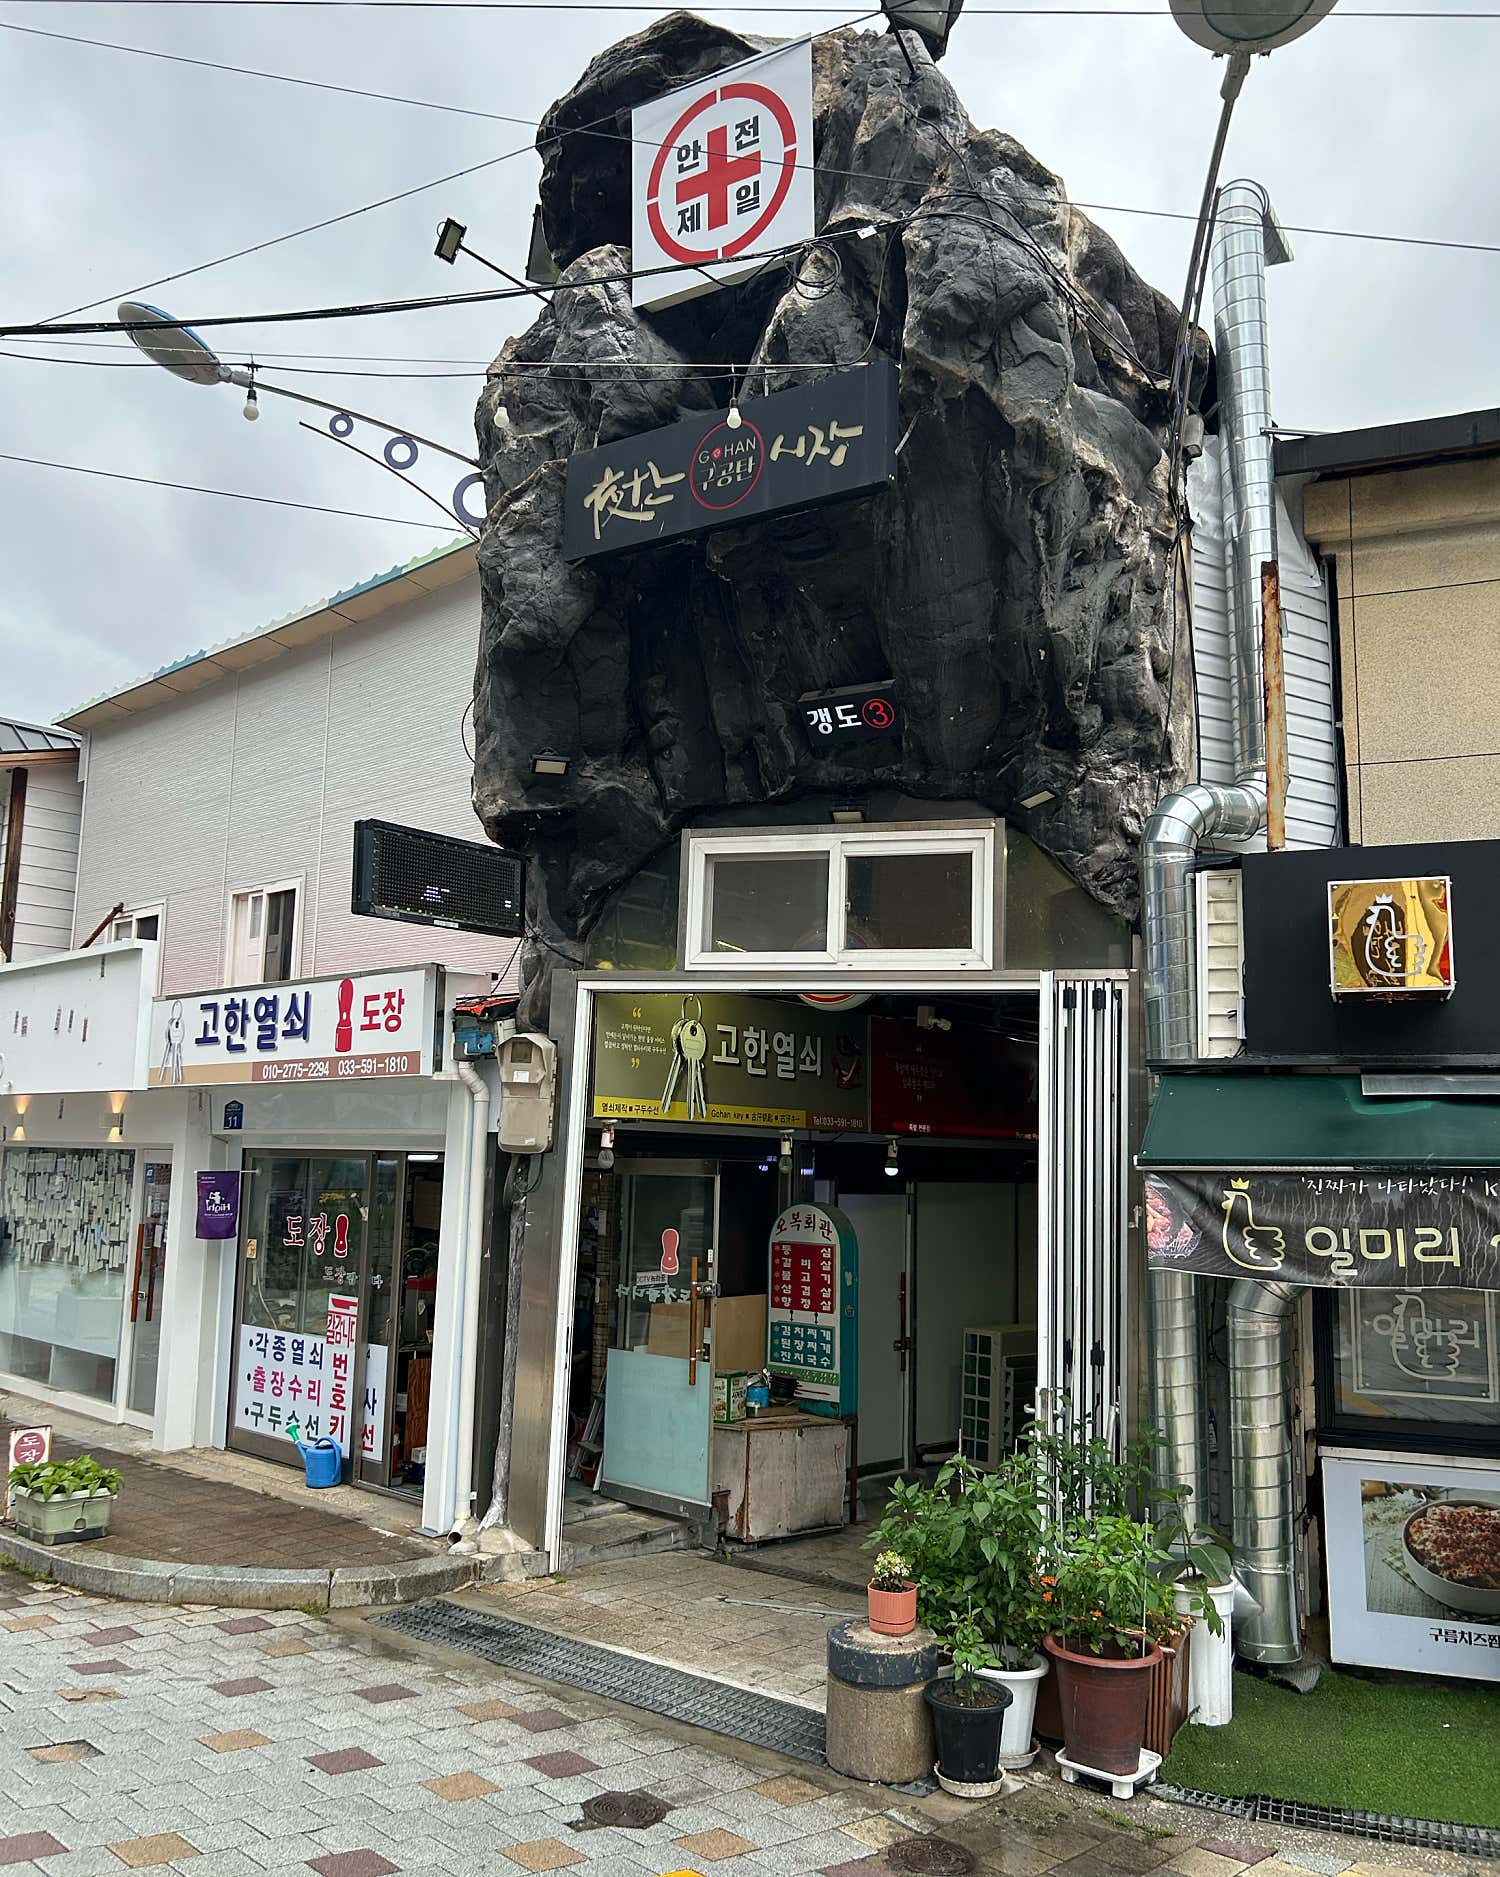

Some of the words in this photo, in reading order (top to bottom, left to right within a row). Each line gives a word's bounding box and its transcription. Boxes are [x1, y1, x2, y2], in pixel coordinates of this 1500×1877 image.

[770, 420, 863, 466] 시장
[807, 704, 862, 734] 갱도
[194, 991, 312, 1051] 고한열쇠
[360, 988, 405, 1032] 도장
[262, 1063, 329, 1080] 010-2775-2294
[338, 1056, 408, 1075] 033-591-1810
[712, 1024, 822, 1079] 고한열쇠
[282, 1213, 331, 1255] 도장
[775, 1211, 833, 1242] 오복회관
[1305, 1226, 1460, 1276] 일미리
[252, 1366, 321, 1406] 출장수리
[329, 1353, 348, 1443] 번호키
[20, 1435, 41, 1462] 도장
